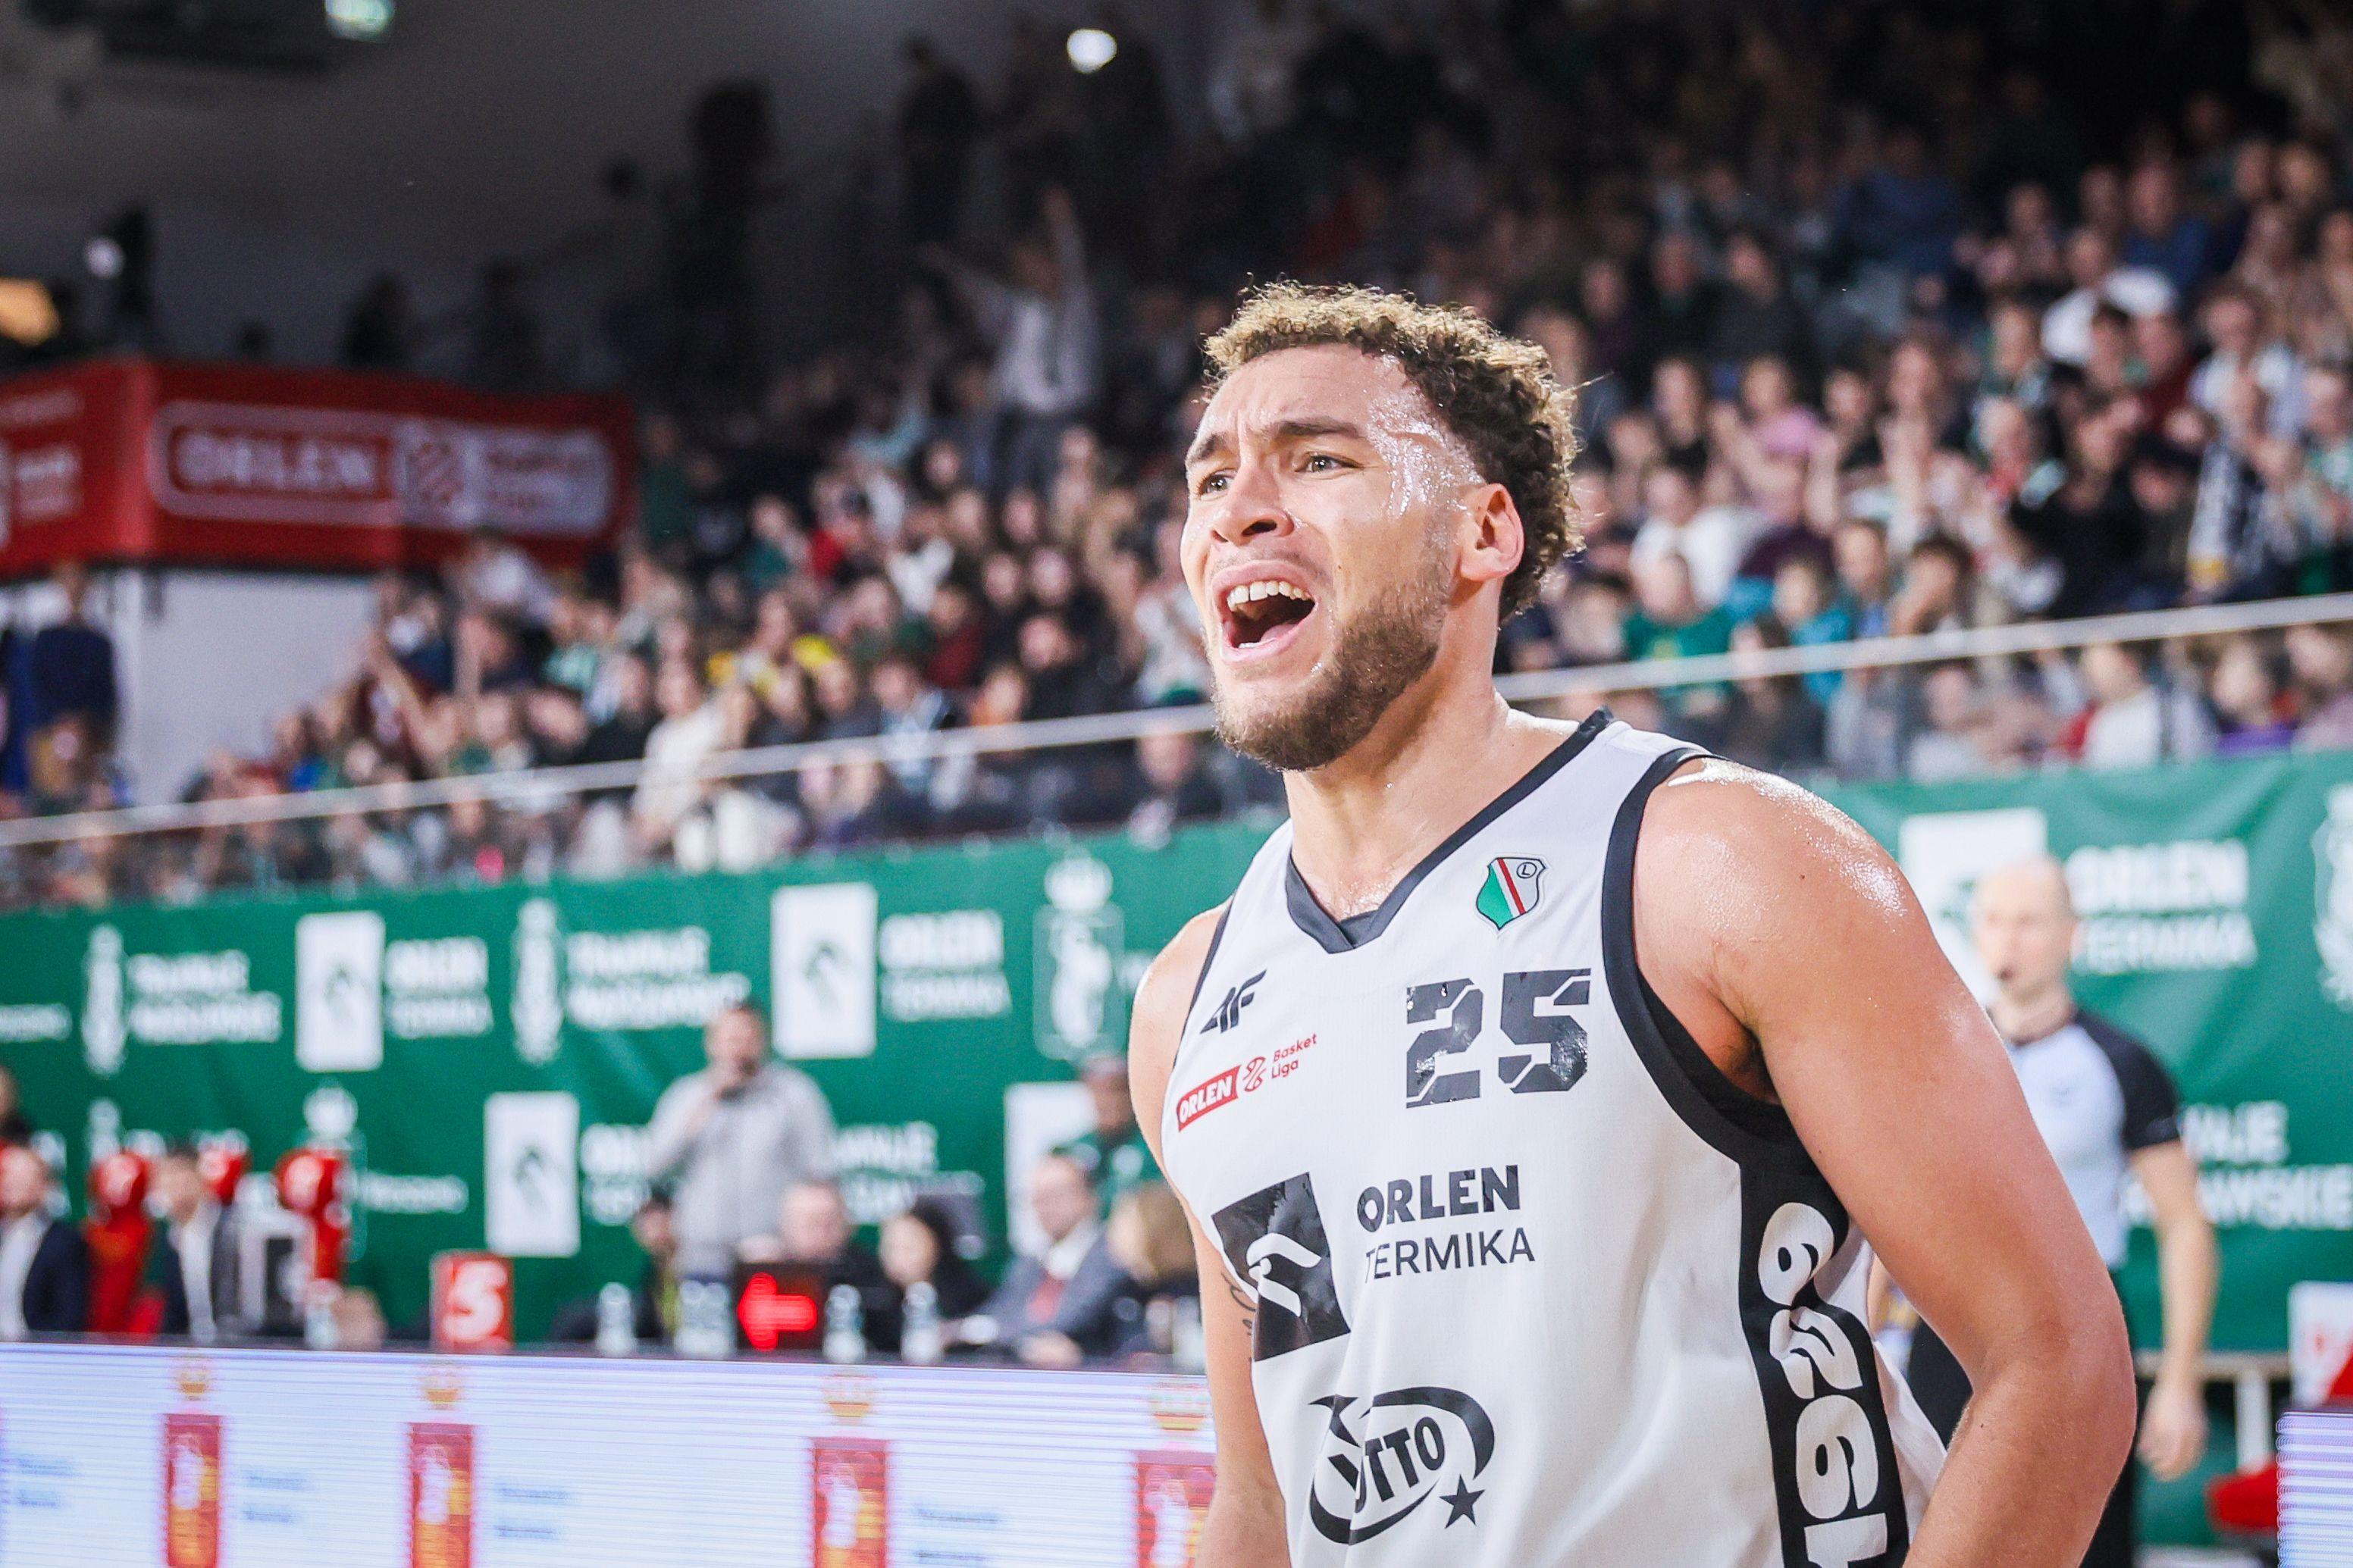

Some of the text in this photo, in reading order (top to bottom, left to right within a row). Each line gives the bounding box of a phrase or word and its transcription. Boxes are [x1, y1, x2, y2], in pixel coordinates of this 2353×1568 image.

[2066, 838, 2248, 912] ORLEN
[1200, 969, 1267, 1034] 4F
[1274, 1034, 1317, 1062] Basket
[1406, 968, 1591, 1109] 25
[1271, 1059, 1299, 1079] Liga
[1180, 1075, 1233, 1124] ORLEN
[1357, 1165, 1521, 1232] ORLEN
[1365, 1228, 1535, 1283] TERMIKA
